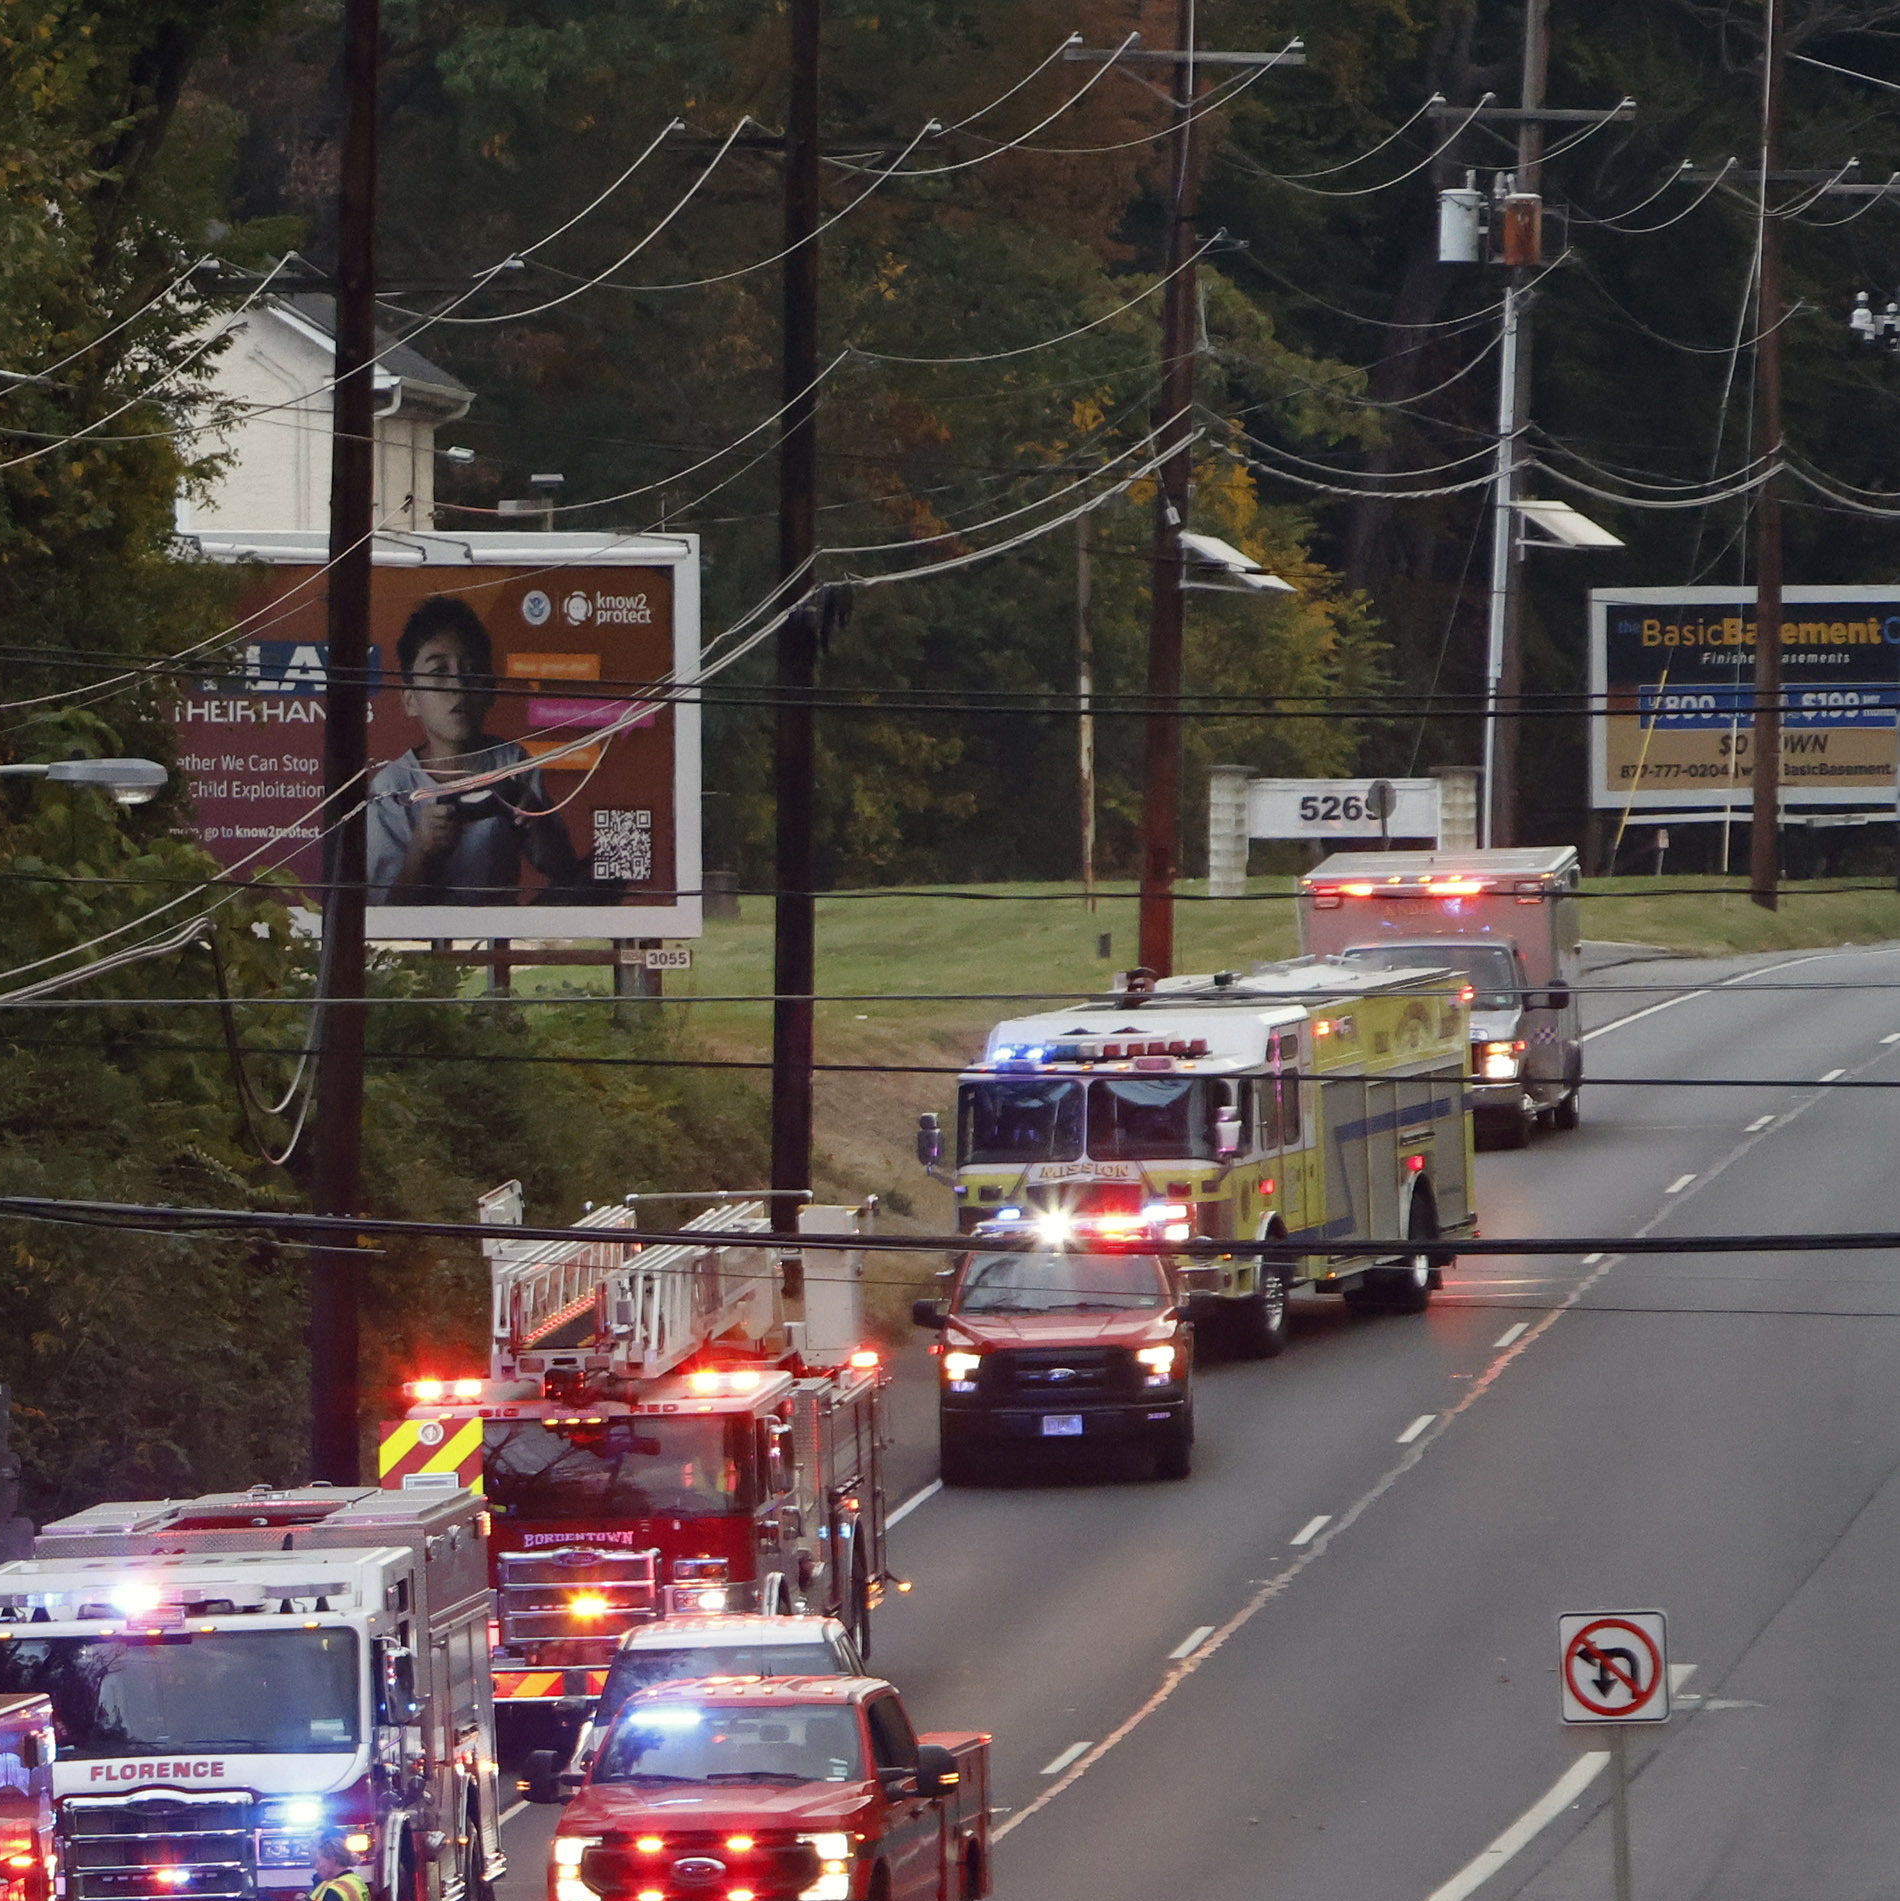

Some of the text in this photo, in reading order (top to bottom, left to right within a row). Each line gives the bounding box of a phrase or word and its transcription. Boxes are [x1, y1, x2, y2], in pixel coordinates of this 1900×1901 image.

[597, 591, 647, 609] know2
[597, 609, 652, 626] protect
[1642, 617, 1882, 647] BasicBaement
[1702, 652, 1851, 664] Finishe asements
[221, 755, 245, 771] We
[249, 755, 278, 771] Can
[282, 754, 319, 775] Stop
[232, 782, 326, 802] Exploitation
[205, 828, 218, 841] go
[222, 826, 234, 837] to
[649, 952, 687, 966] 3055
[1039, 1162, 1129, 1179] MISSION
[523, 1531, 634, 1548] BORDENTOWN
[90, 1761, 225, 1781] FLORENCE
